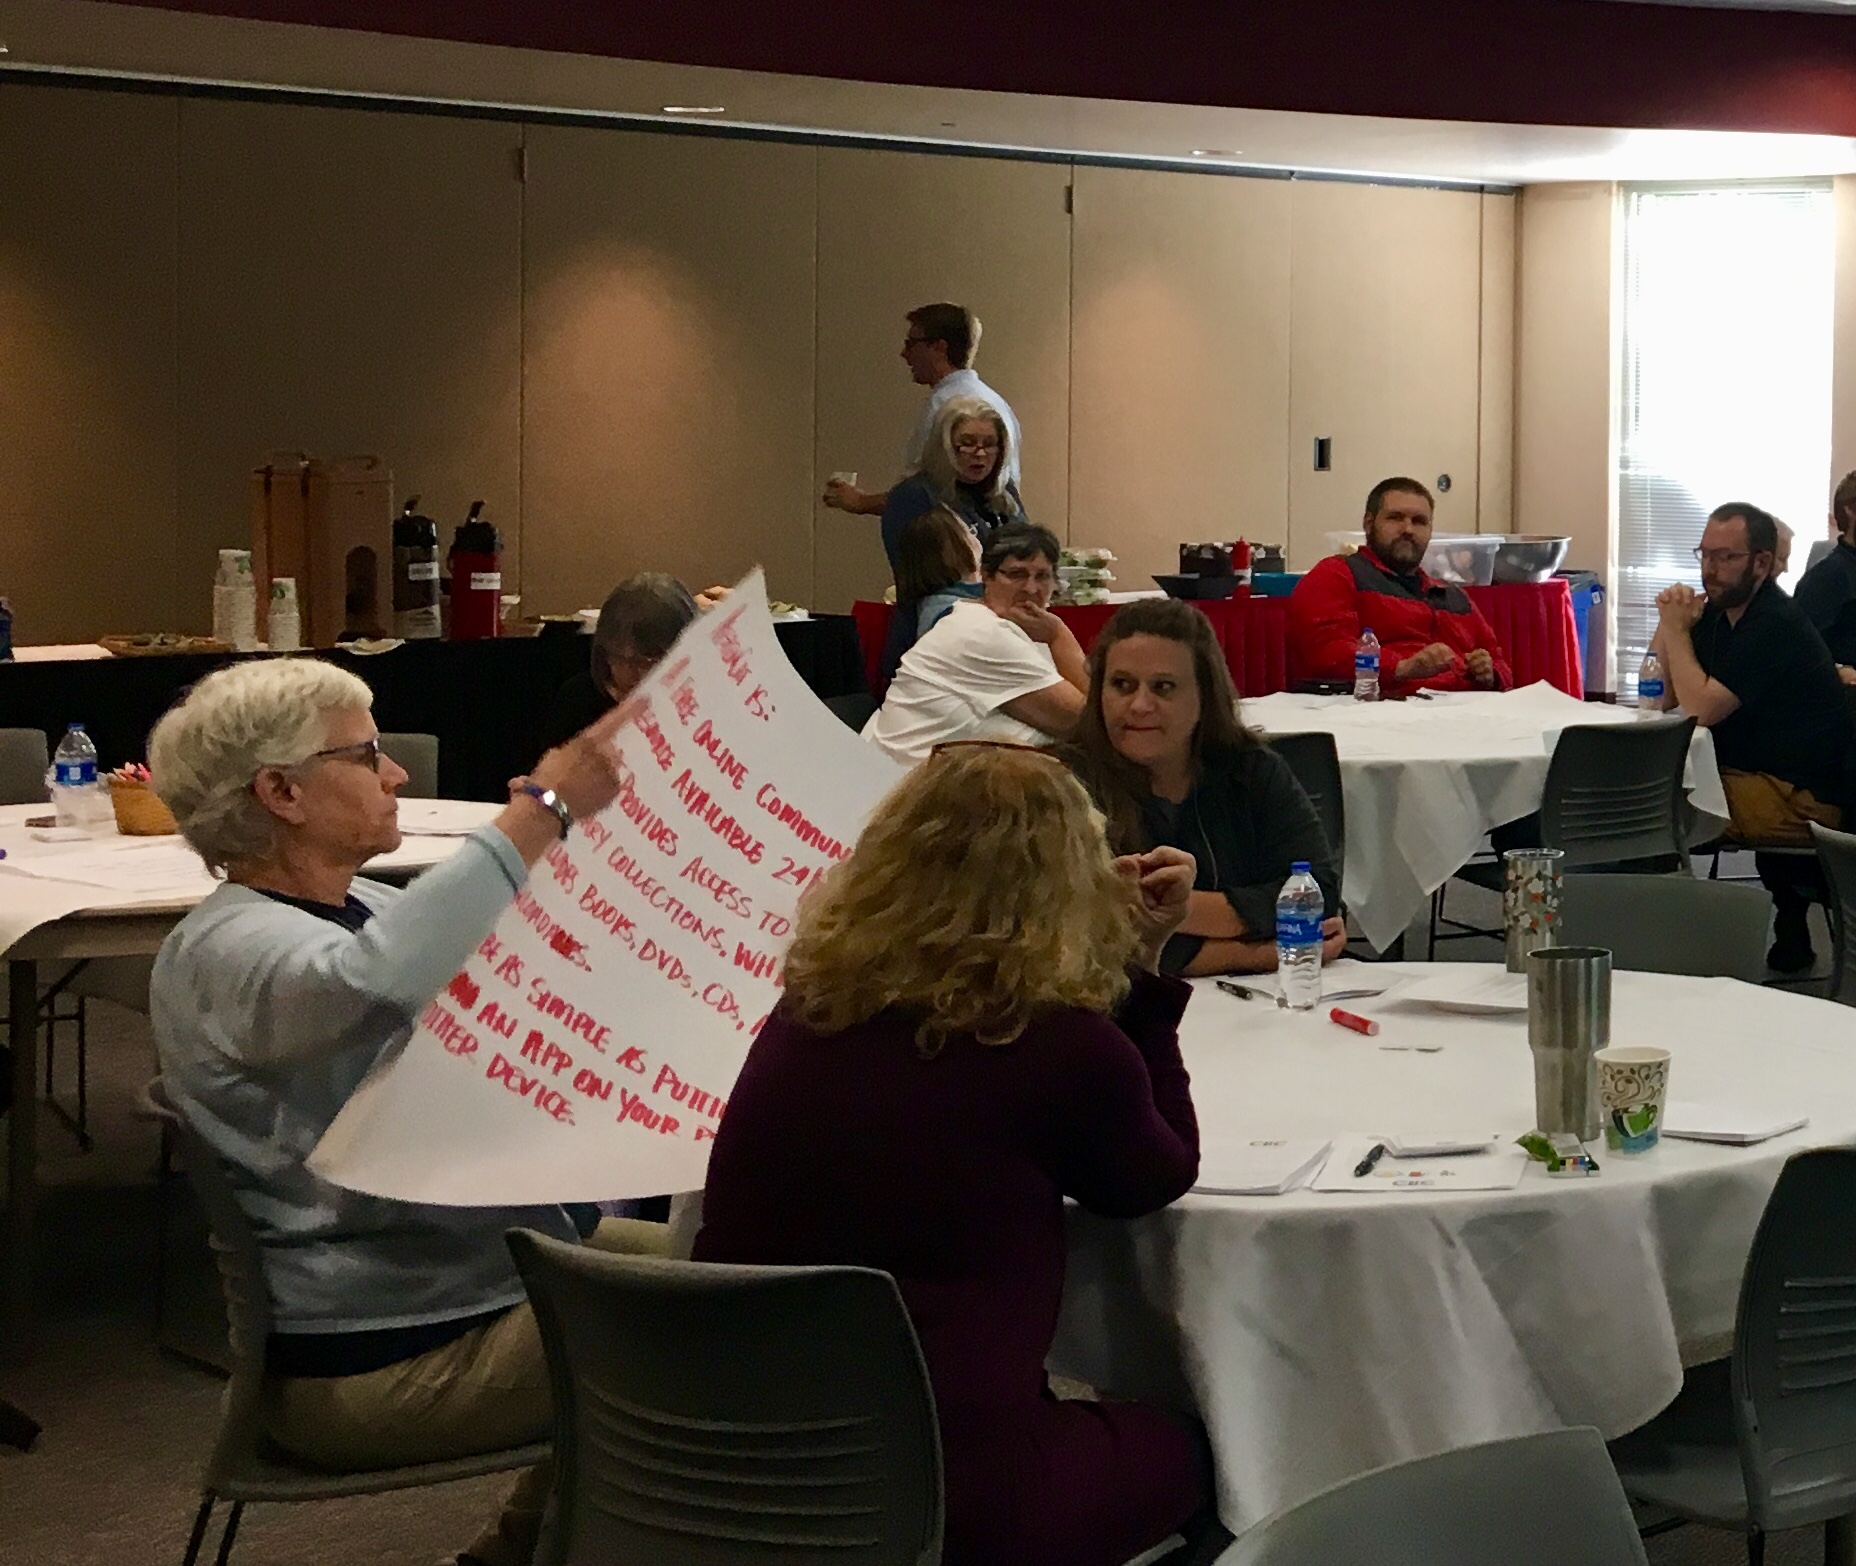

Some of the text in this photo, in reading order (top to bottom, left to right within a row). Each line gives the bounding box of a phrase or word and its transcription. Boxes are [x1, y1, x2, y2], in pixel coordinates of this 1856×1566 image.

[693, 719, 749, 791] ONLINE
[670, 767, 765, 865] AVAILABLE
[679, 855, 753, 919] ACCESS
[758, 909, 791, 937] TO
[526, 976, 613, 1055] SIMPLE
[476, 1000, 681, 1138] AN APP ON YOUR
[486, 1052, 576, 1127] DEVICE.
